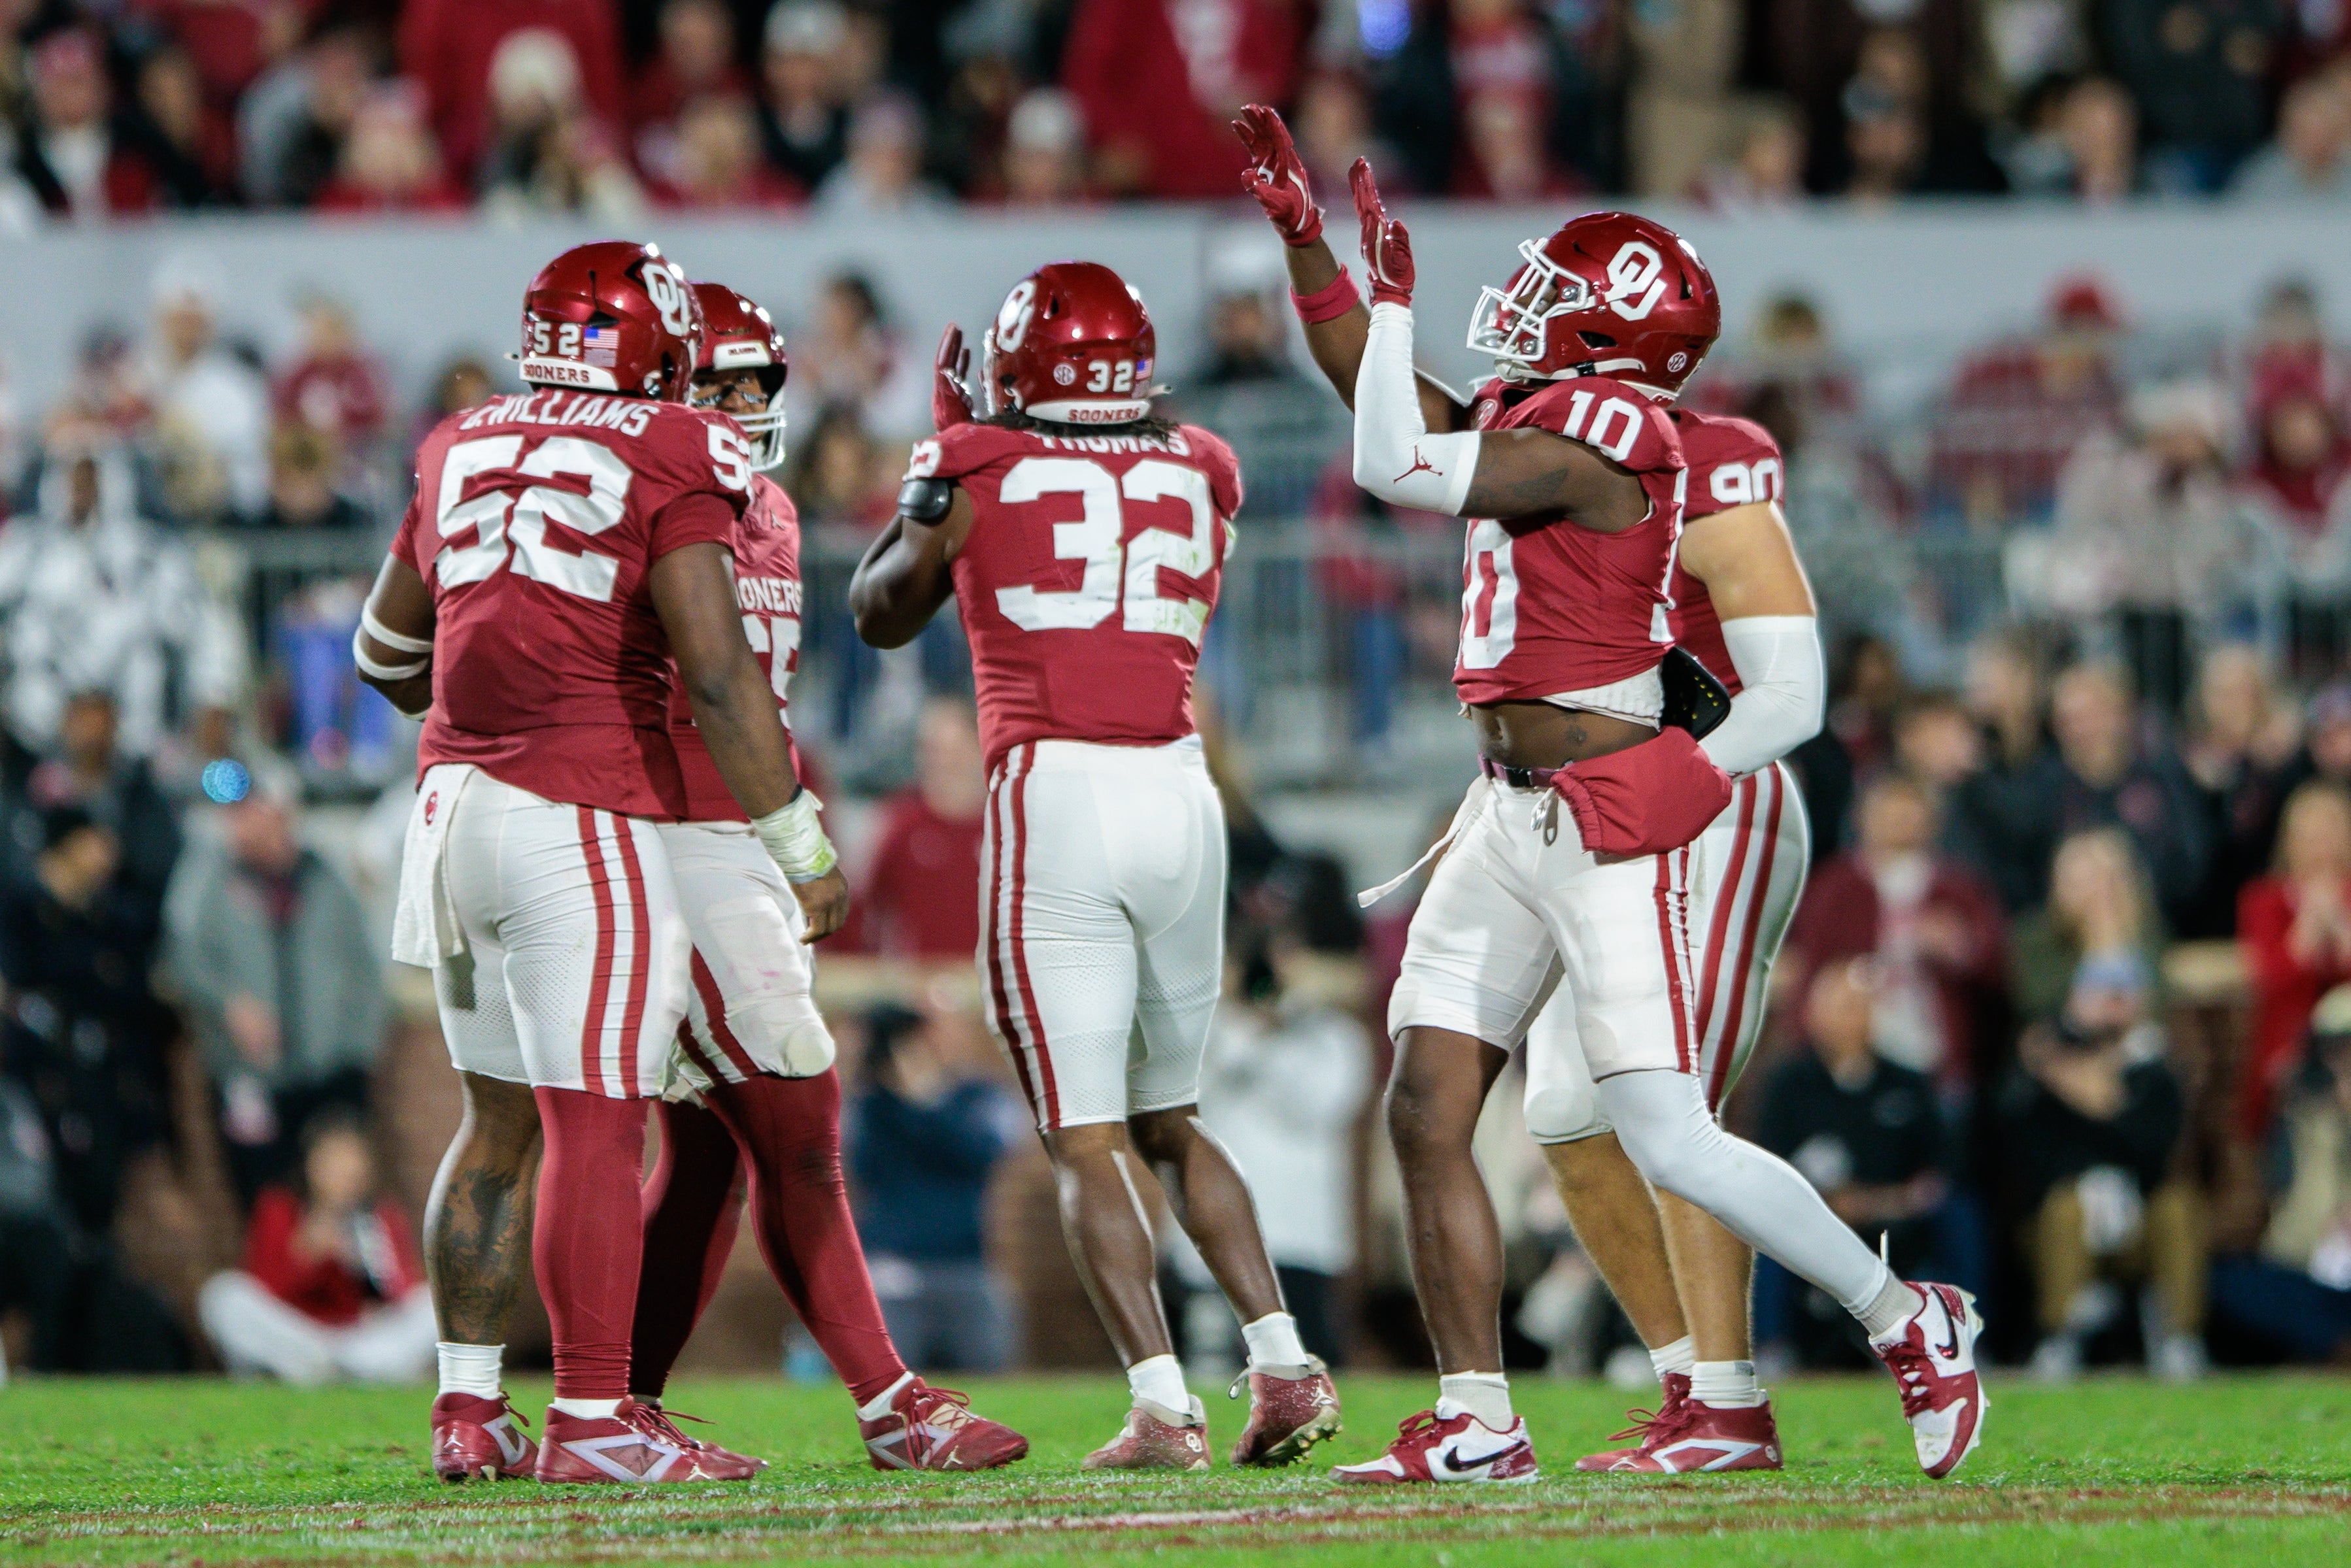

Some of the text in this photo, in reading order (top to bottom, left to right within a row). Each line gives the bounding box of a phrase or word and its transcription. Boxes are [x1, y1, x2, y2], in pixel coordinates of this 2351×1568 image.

[1606, 241, 1666, 321] OU
[533, 322, 580, 356] 52
[524, 363, 590, 382] SOONERS
[1087, 360, 1134, 392] 32
[1068, 407, 1140, 422] SOONERS
[1557, 390, 1644, 461] 10
[435, 435, 633, 603] 52
[995, 458, 1214, 648] 32
[736, 576, 802, 616] ONERS
[1185, 1433, 1203, 1452] OU
